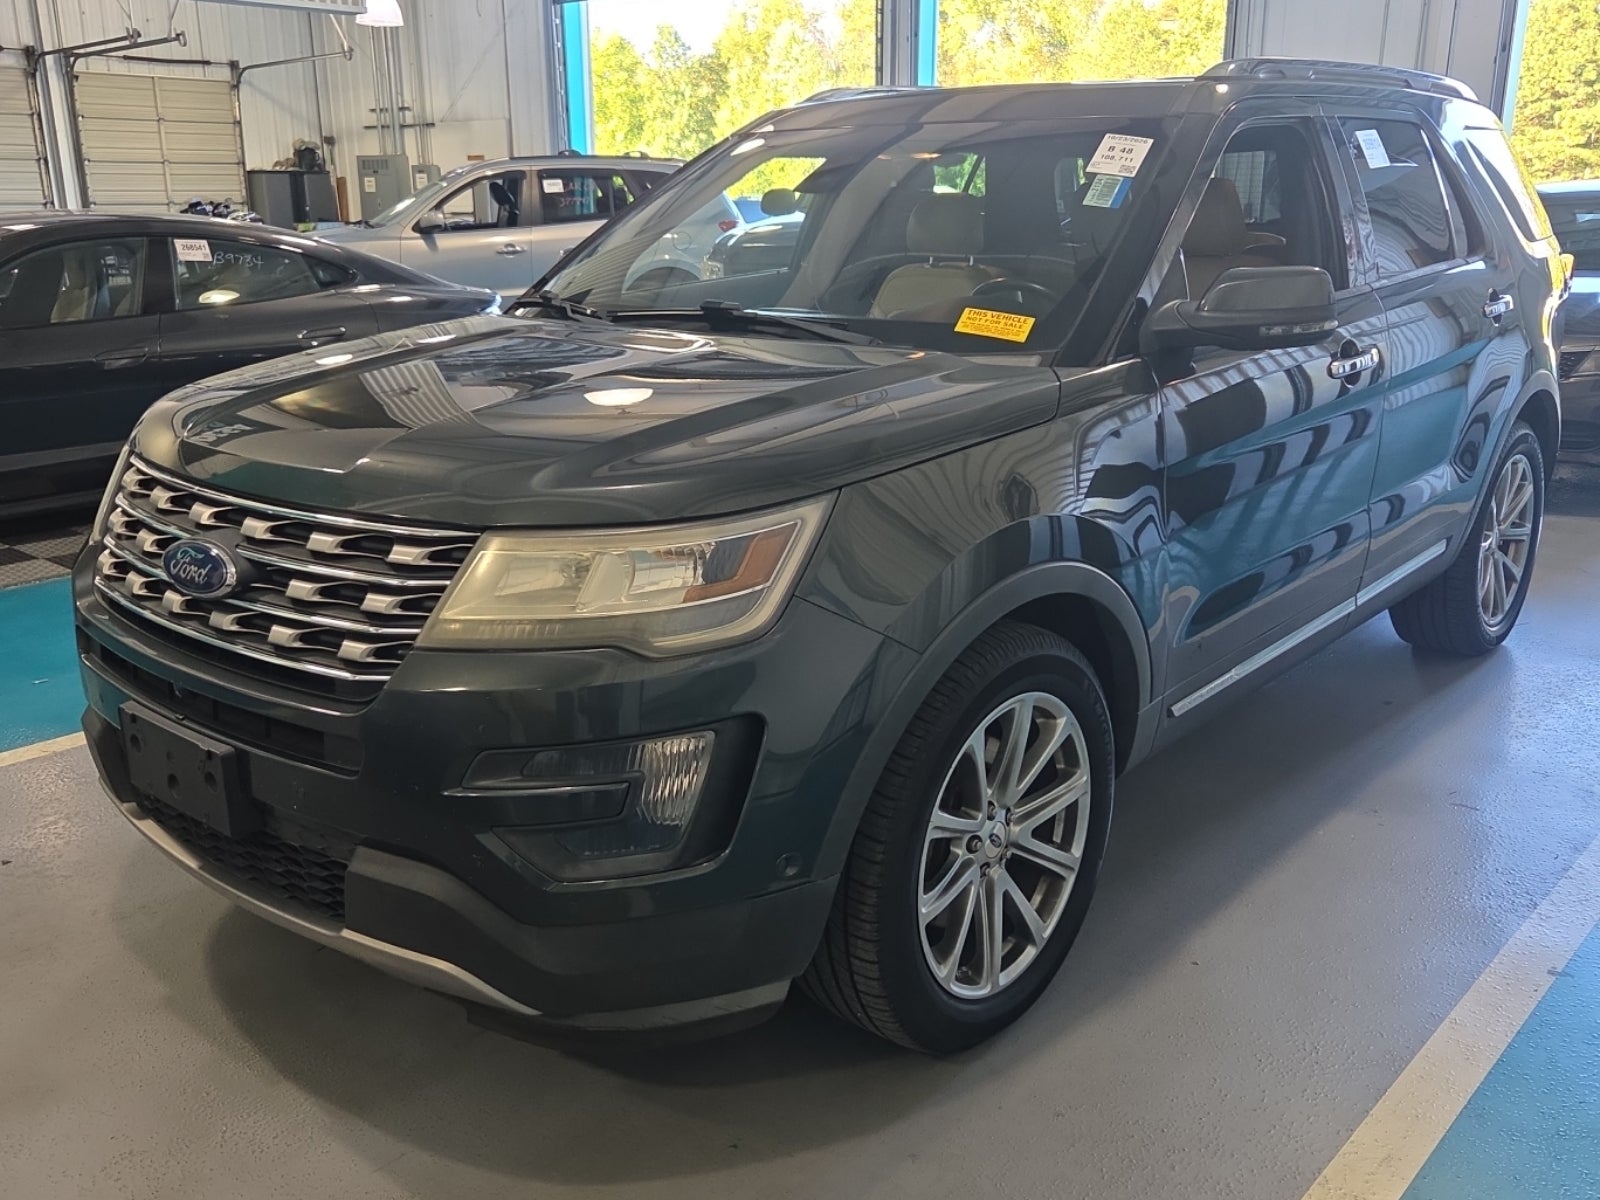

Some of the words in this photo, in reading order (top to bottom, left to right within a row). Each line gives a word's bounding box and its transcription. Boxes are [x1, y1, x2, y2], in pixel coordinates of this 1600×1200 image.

[1120, 147, 1134, 155] 48
[967, 309, 988, 318] THIS
[991, 312, 1030, 325] VEHICLE
[1003, 321, 1024, 330] SALE
[170, 547, 212, 584] Ford
